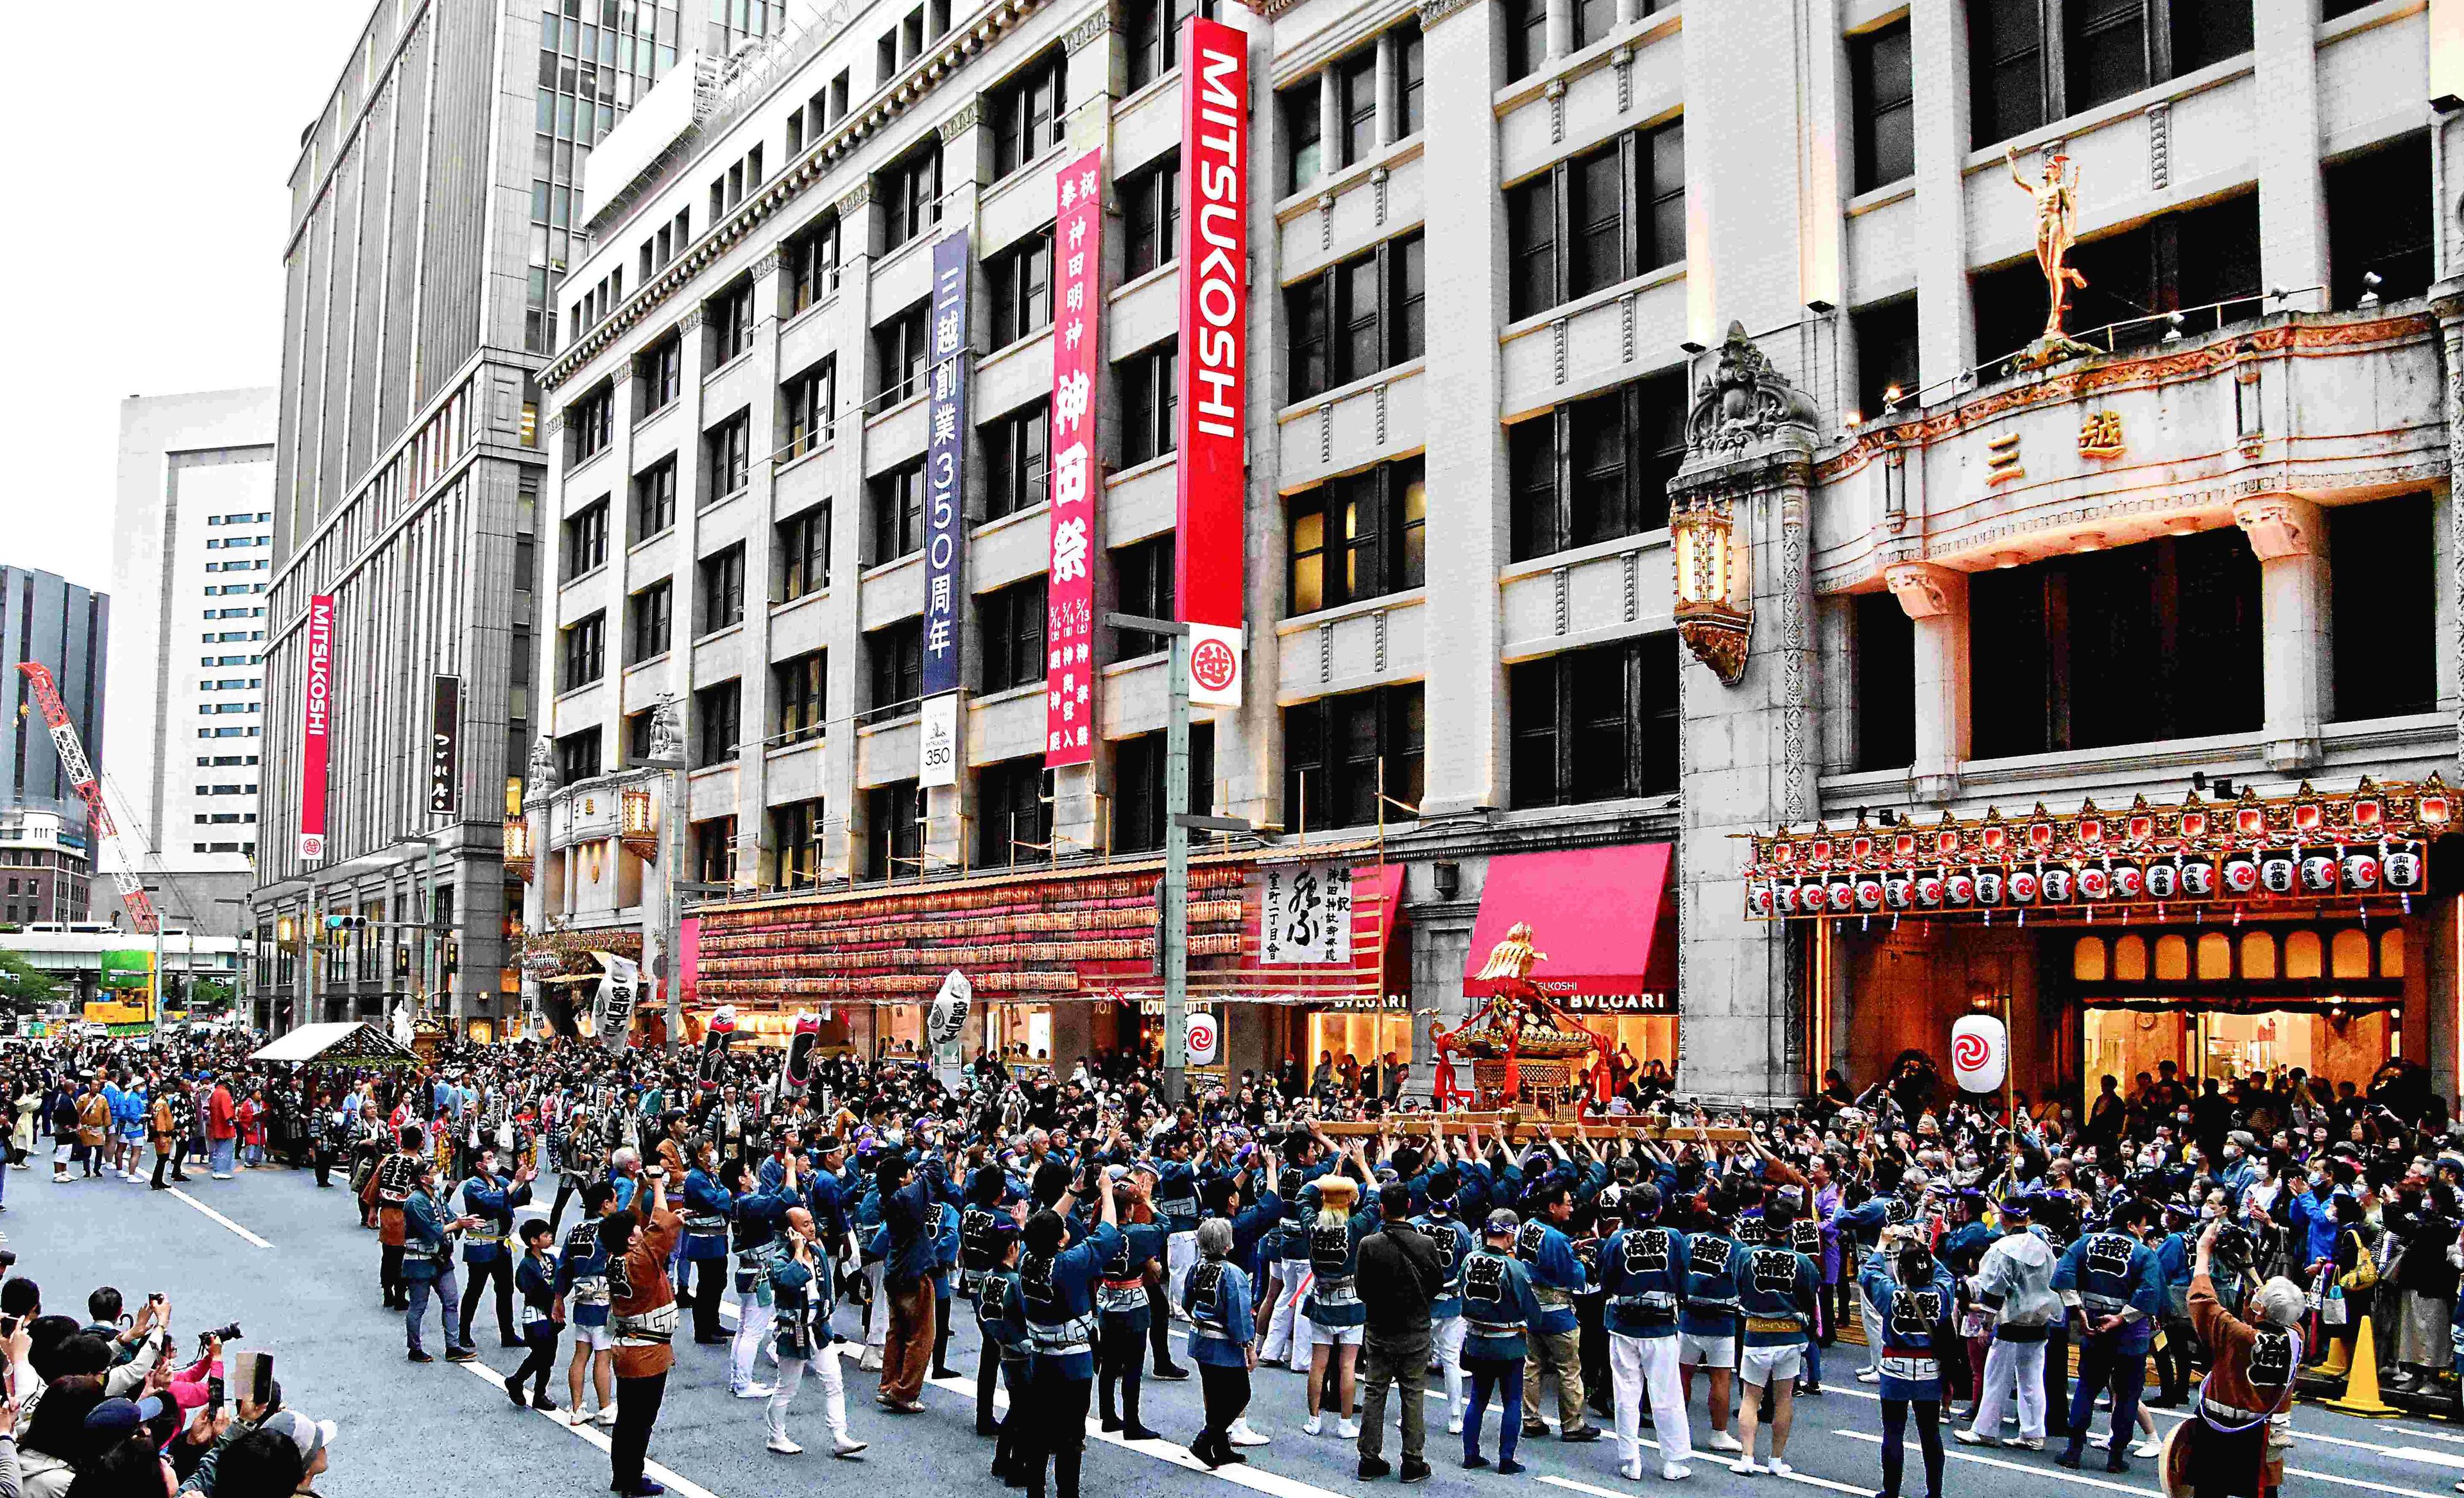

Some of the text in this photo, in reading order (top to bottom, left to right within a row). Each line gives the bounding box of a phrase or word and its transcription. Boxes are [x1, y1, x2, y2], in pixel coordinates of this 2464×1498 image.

[1065, 216, 1087, 352] 神田明神
[1197, 48, 1238, 439] MITSUKOSHI
[928, 266, 959, 659] 三越創業350周年
[1053, 369, 1090, 585] 神田祭
[309, 605, 328, 735] MITSUKOSHI
[925, 747, 950, 766] 350
[1538, 982, 1577, 991] SUKOSHI
[1570, 993, 1664, 1008] BVLGARI
